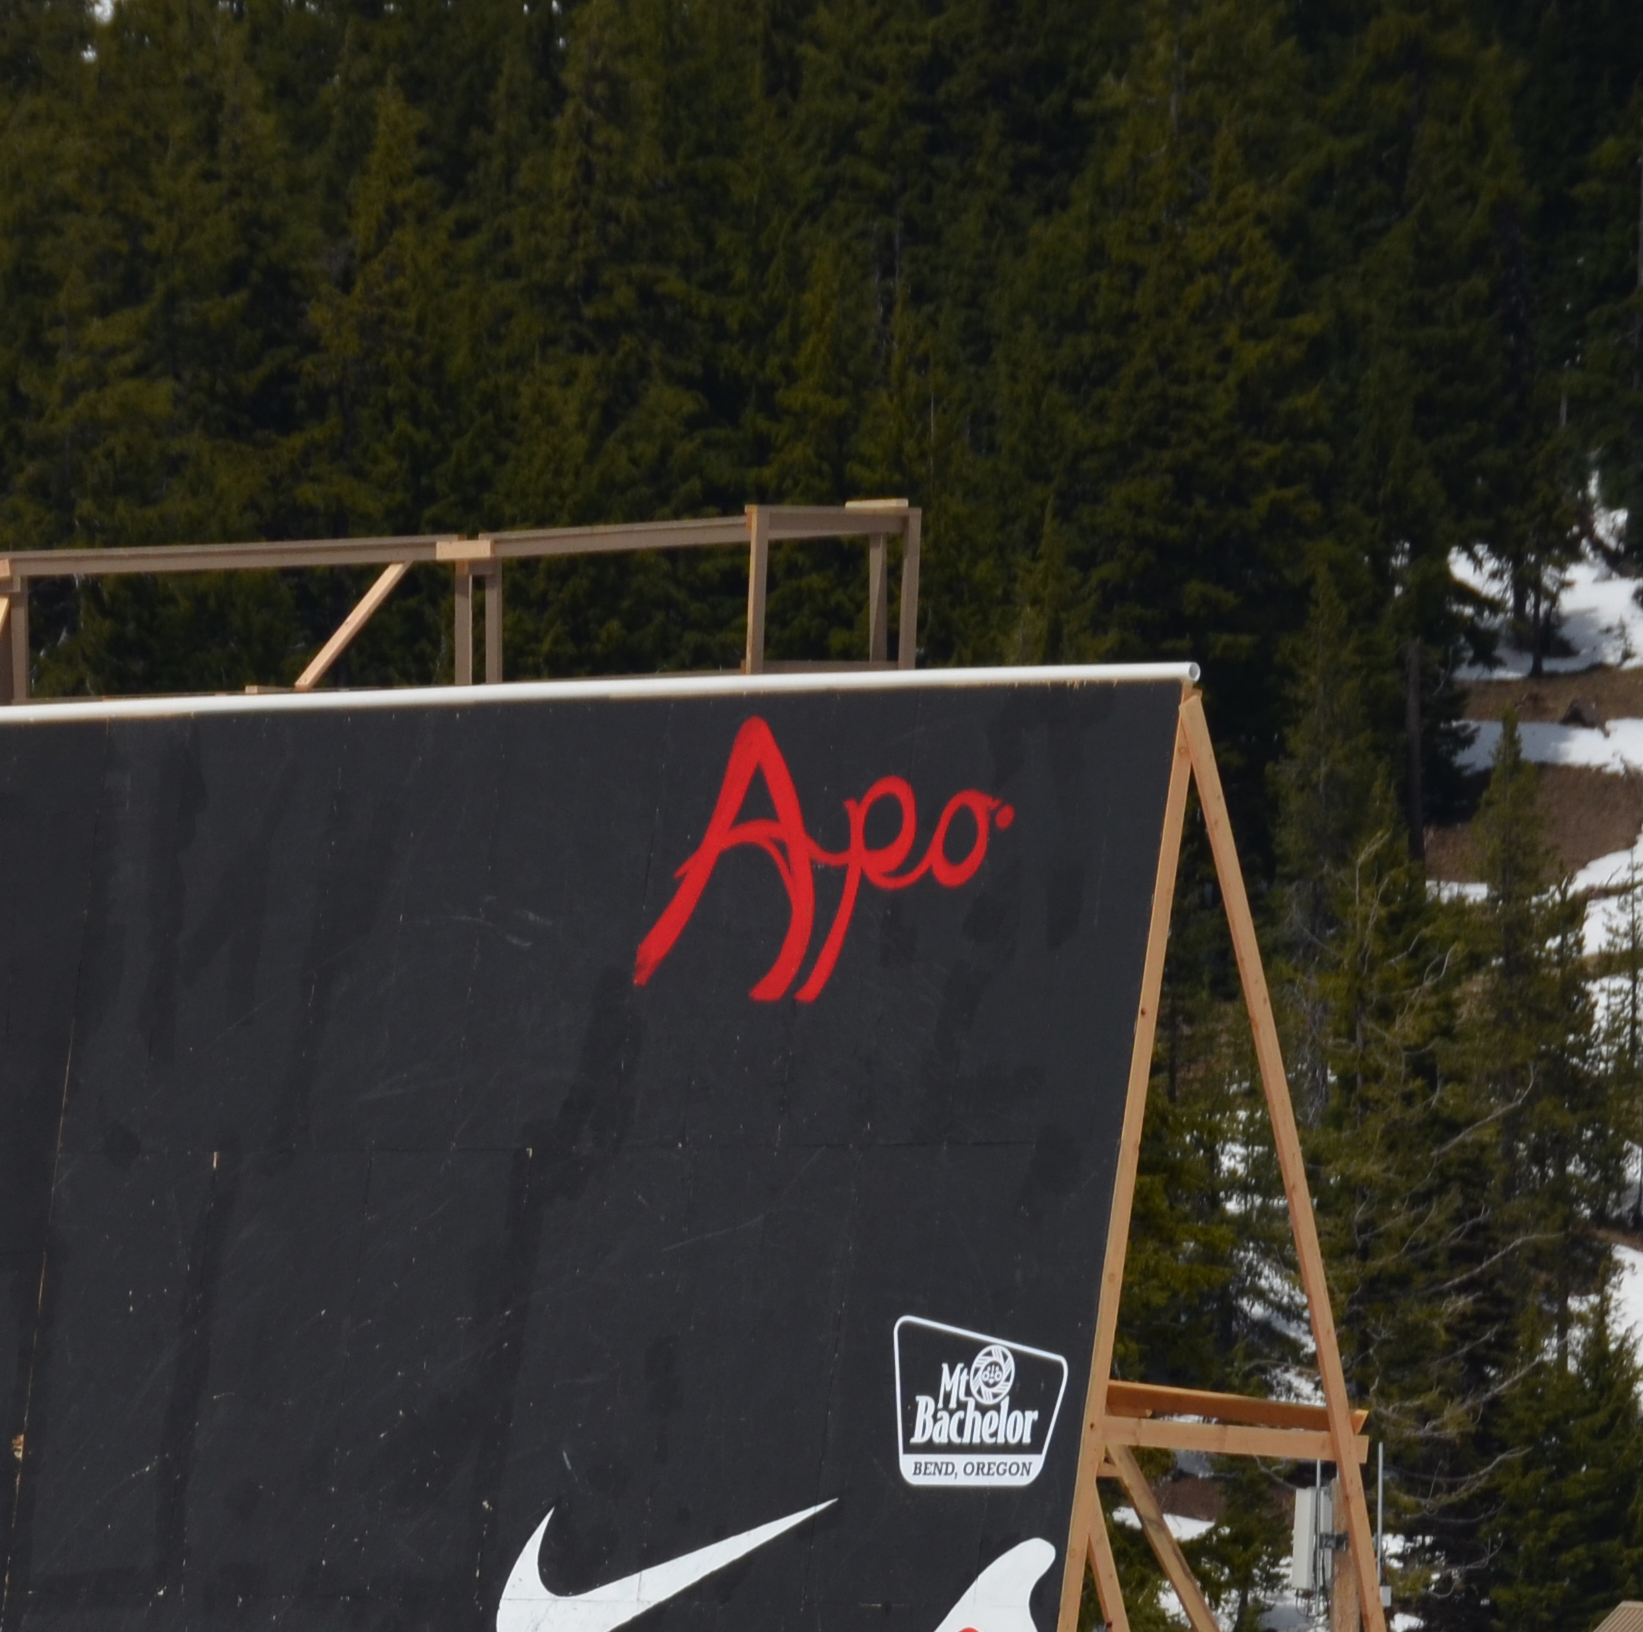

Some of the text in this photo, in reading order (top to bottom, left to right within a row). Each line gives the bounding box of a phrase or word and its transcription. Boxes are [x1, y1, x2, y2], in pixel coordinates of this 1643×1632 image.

[634, 716, 1015, 1002] Apo
[937, 1362, 970, 1409] Mt
[909, 1395, 1039, 1444] Bachelor
[912, 1461, 1033, 1479] BEND, OREGON
